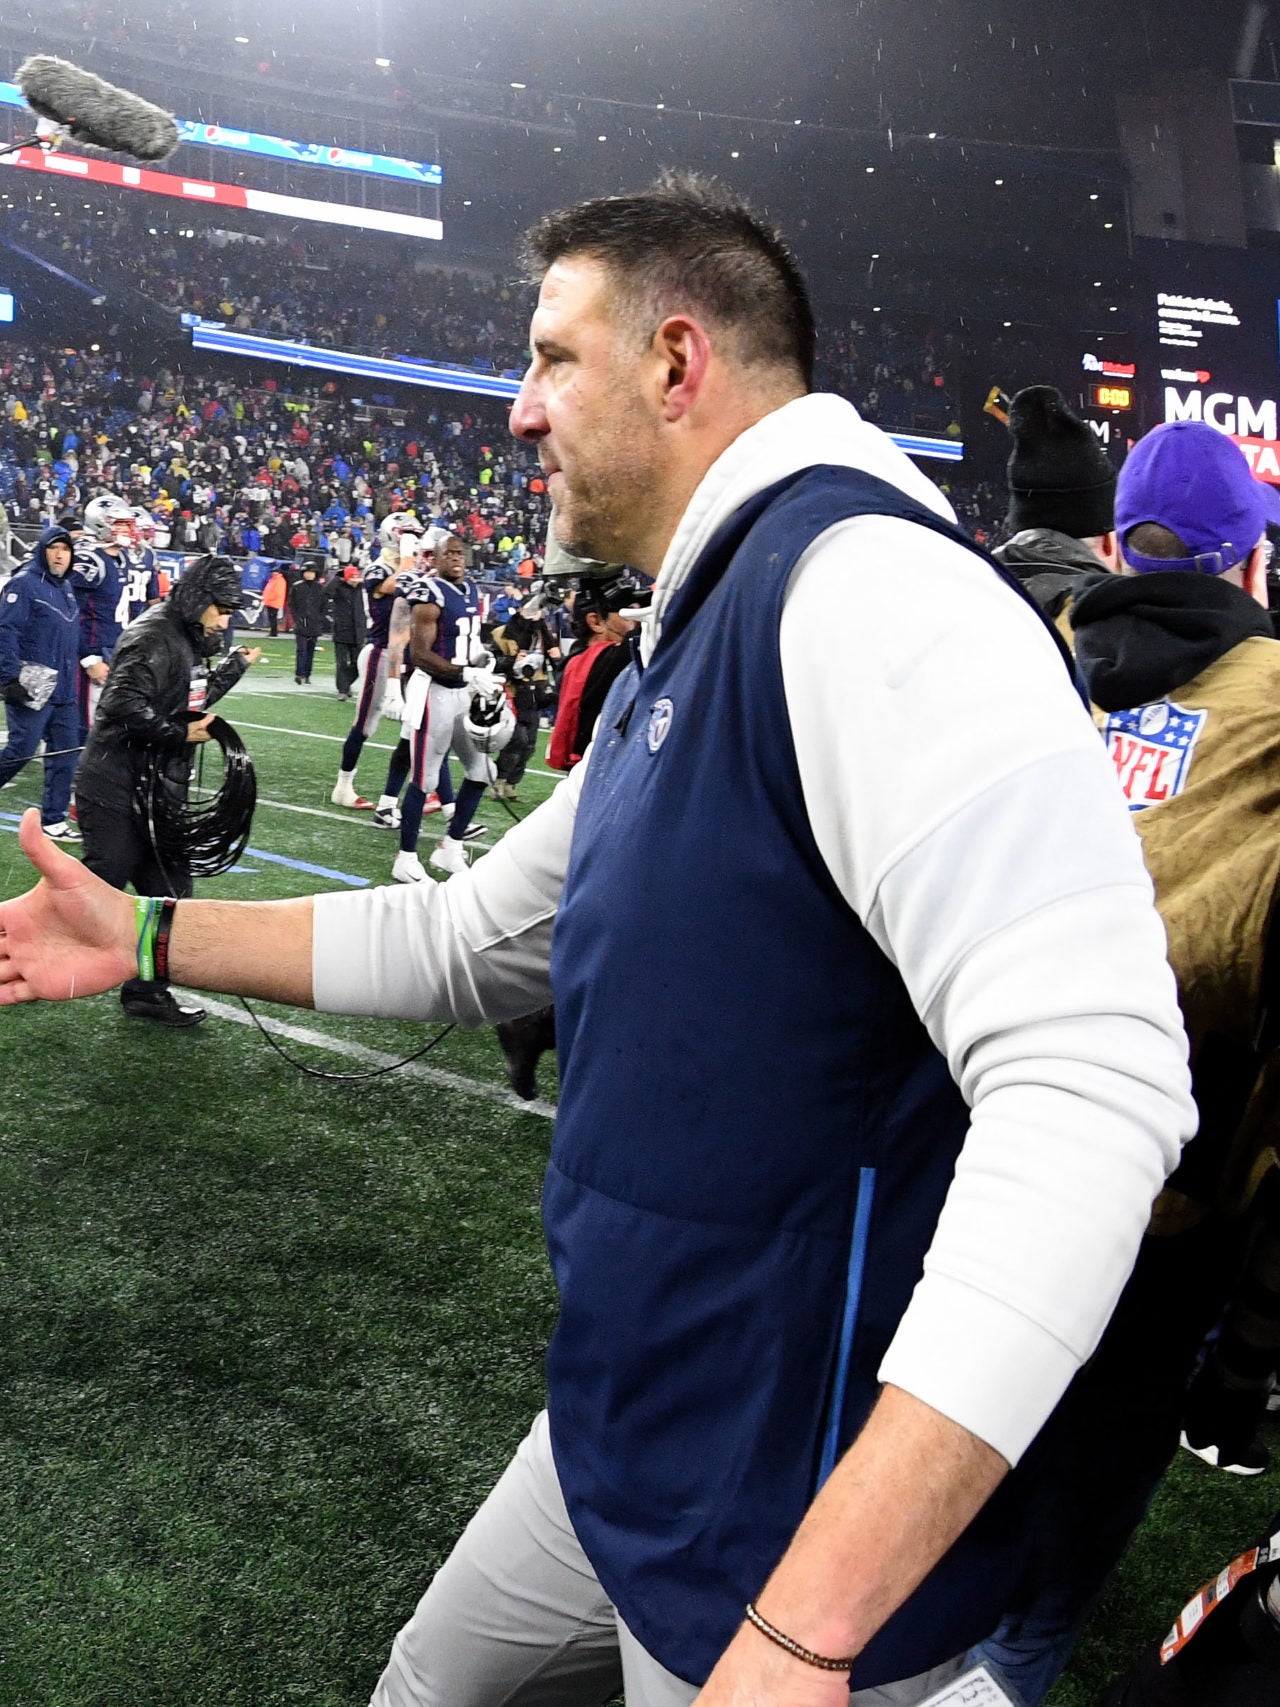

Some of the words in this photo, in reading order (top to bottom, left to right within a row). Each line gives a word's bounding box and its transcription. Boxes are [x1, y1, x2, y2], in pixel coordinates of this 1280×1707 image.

[1098, 387, 1131, 407] 0:00
[1165, 386, 1278, 441] MGM
[1112, 735, 1170, 800] NFL
